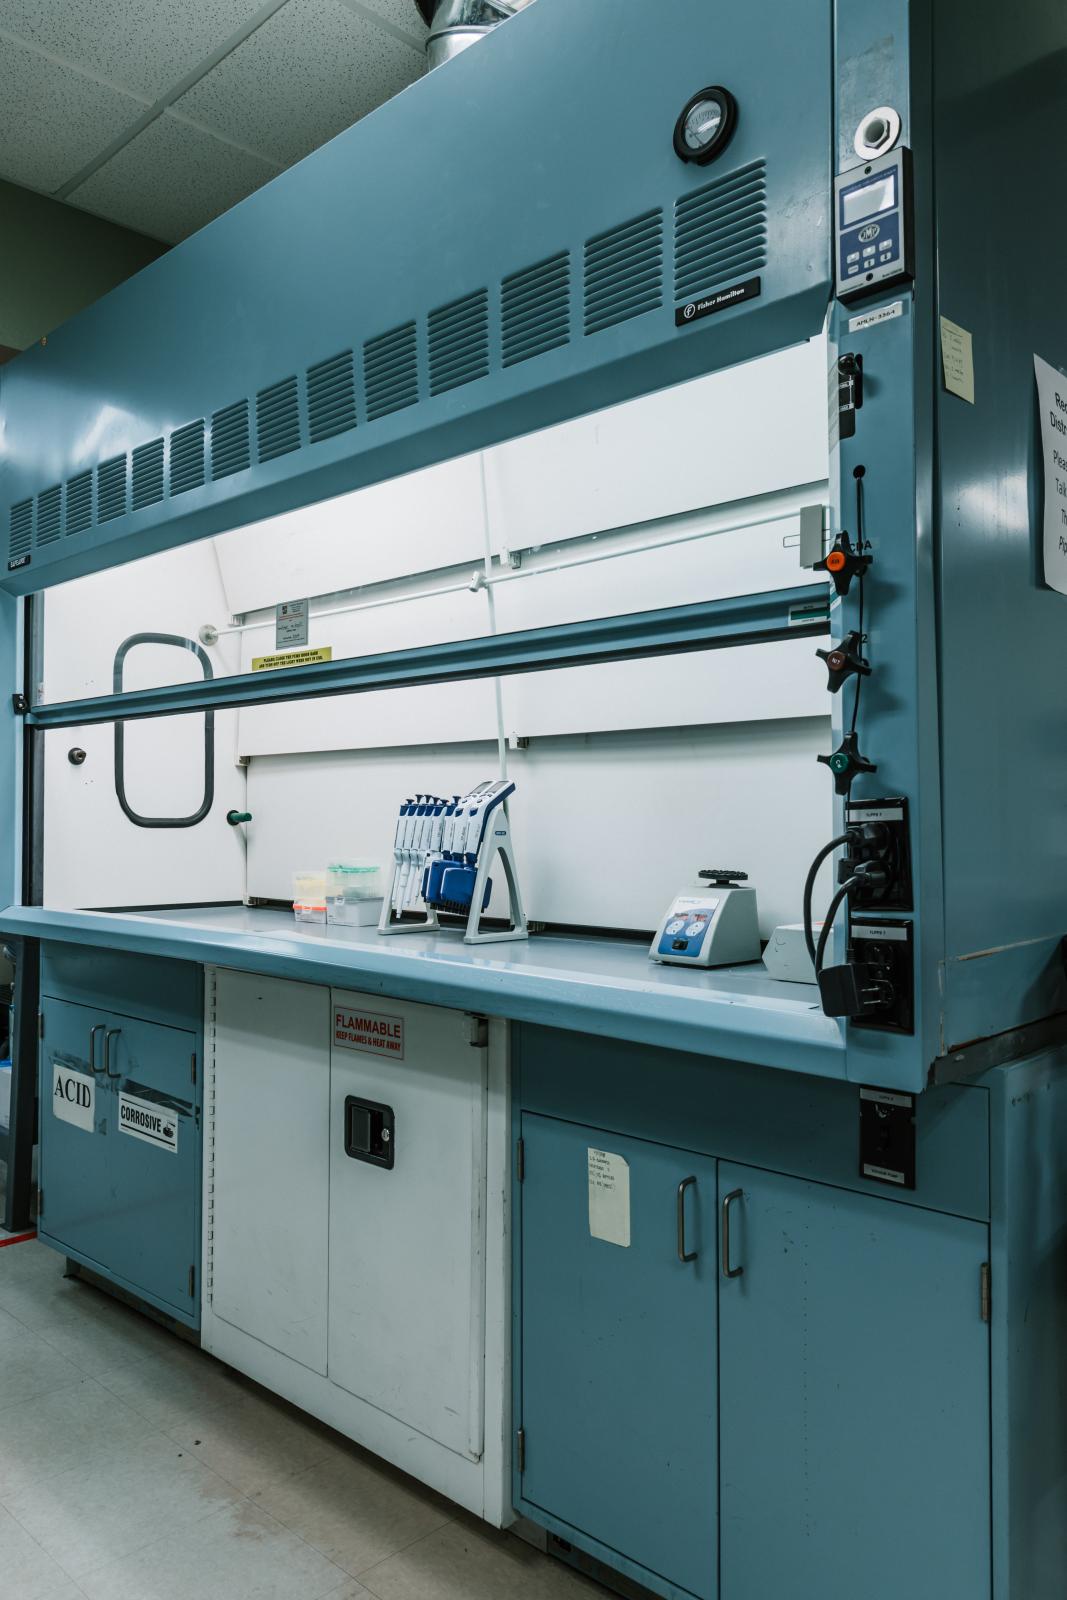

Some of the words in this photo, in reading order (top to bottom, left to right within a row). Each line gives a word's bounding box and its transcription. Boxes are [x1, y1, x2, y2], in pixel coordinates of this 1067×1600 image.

[698, 300, 715, 311] Fisher
[717, 289, 745, 303] Hamilton
[336, 1014, 401, 1039] FLAMMABLE
[336, 1031, 348, 1040] KEEP
[349, 1033, 367, 1044] FLAMES
[373, 1038, 385, 1048] HEAT
[386, 1041, 400, 1051] AWAY
[54, 1076, 90, 1108] ACID
[121, 1105, 161, 1133] CORROSIVE
